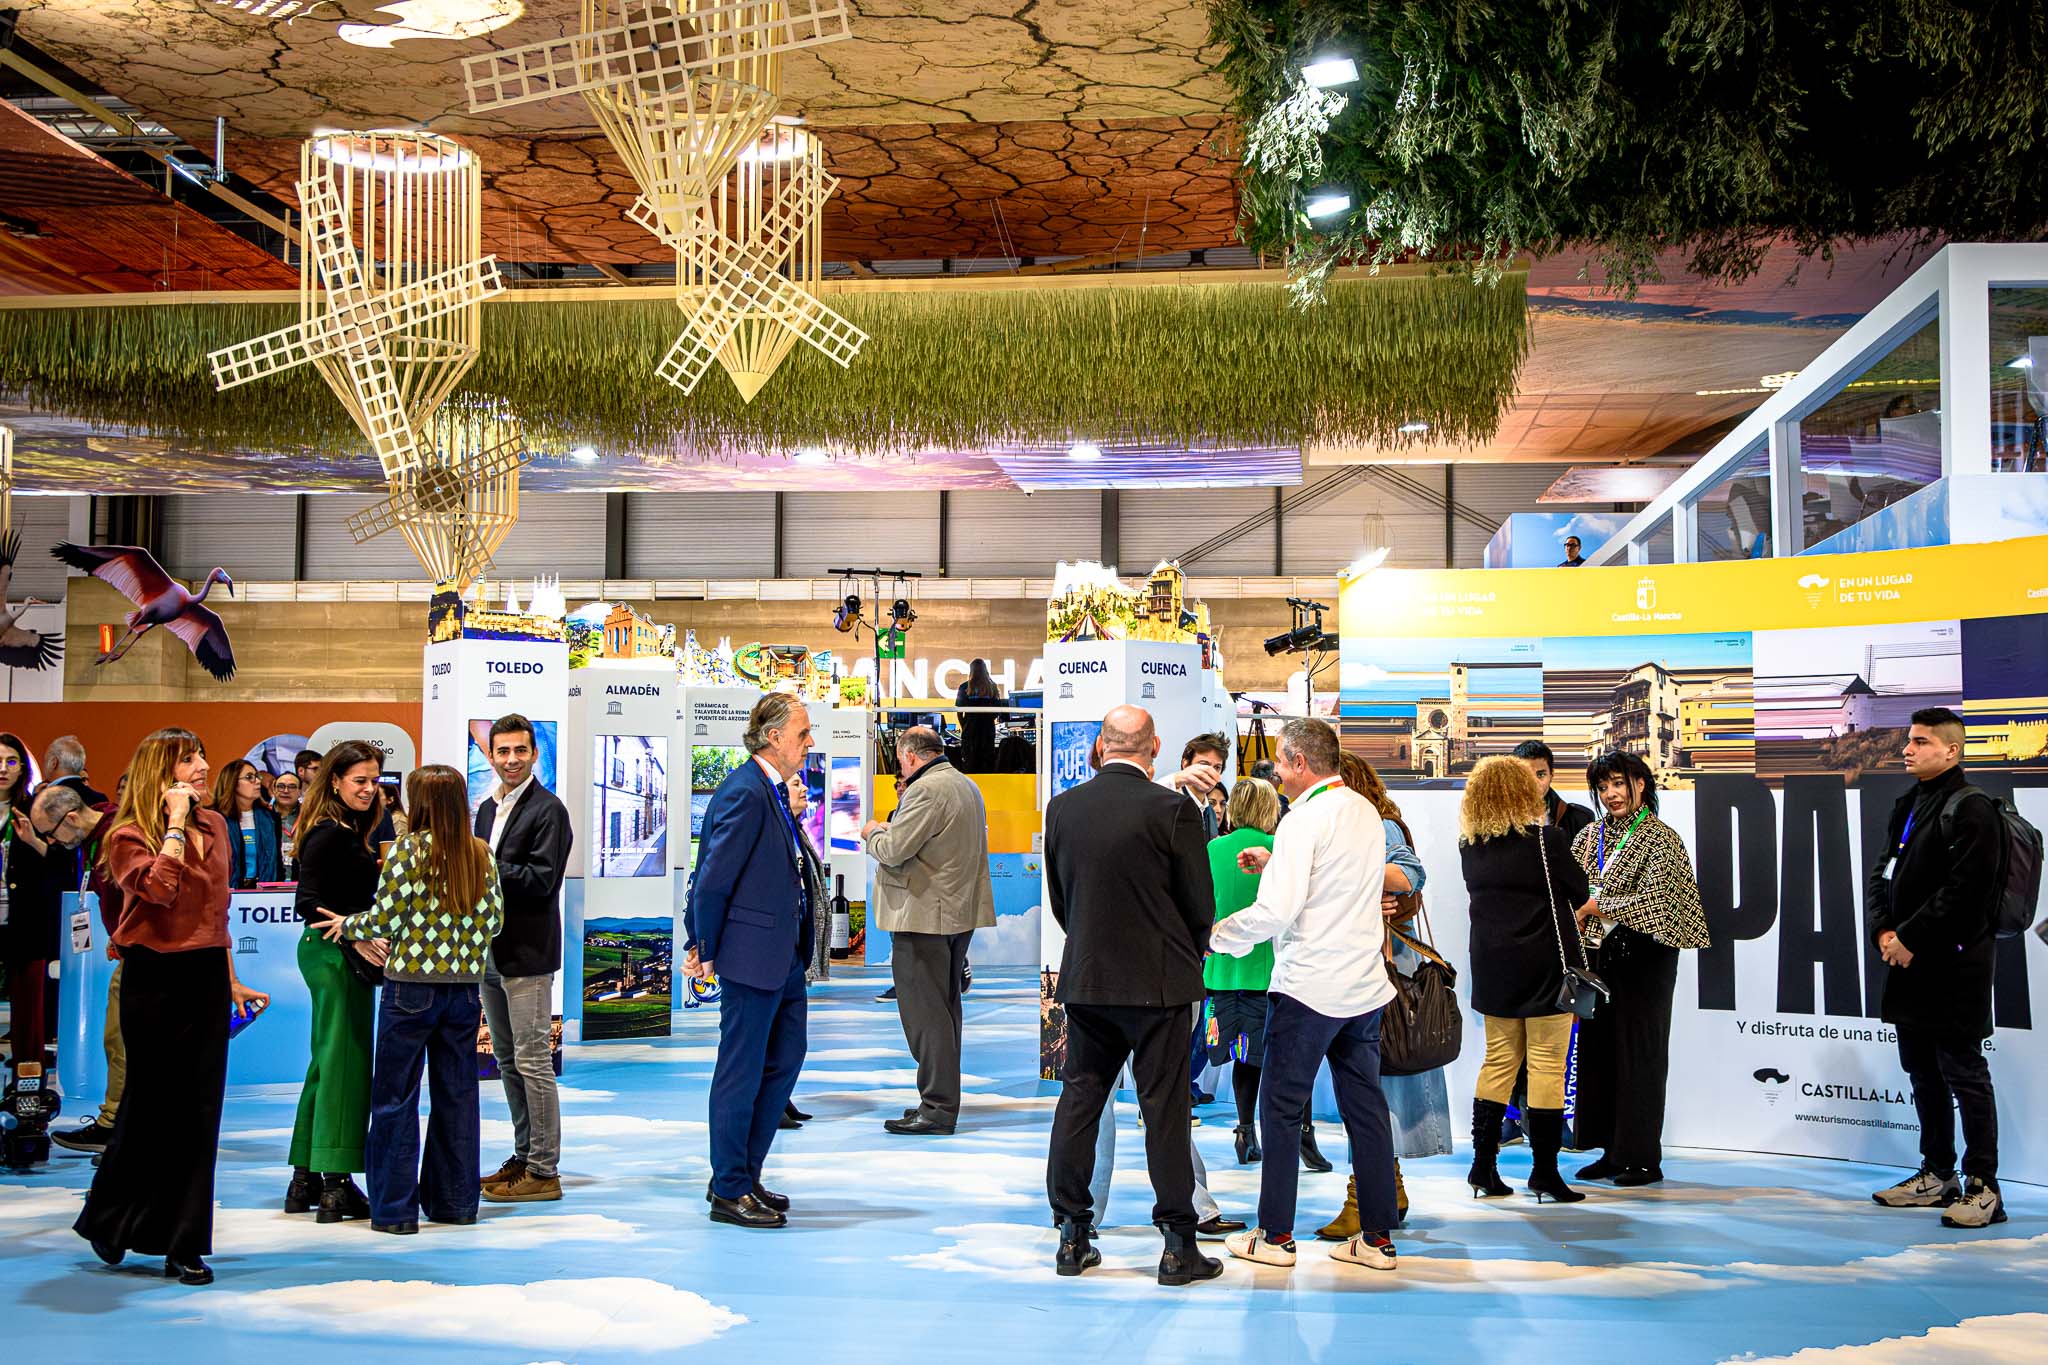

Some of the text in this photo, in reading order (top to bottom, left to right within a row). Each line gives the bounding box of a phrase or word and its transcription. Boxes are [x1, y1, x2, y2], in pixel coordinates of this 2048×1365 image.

[1839, 573, 1913, 588] EN UN LUGAR
[1839, 589, 1900, 603] DE TU VIDA
[432, 662, 451, 676] TOLEDO
[486, 661, 544, 674] TOLEDO
[1059, 660, 1108, 675] CUENCA
[1141, 661, 1187, 677] CUENCA
[605, 684, 660, 697] ALMADÉN
[1737, 1021, 1746, 1034] Y
[1751, 1021, 1814, 1038] disfruta
[1819, 1025, 1838, 1039] de
[1843, 1028, 1872, 1041] una
[1801, 1082, 1906, 1105] CASTILLA-LA
[1795, 1113, 1920, 1132] www.turismocastillalamanc
